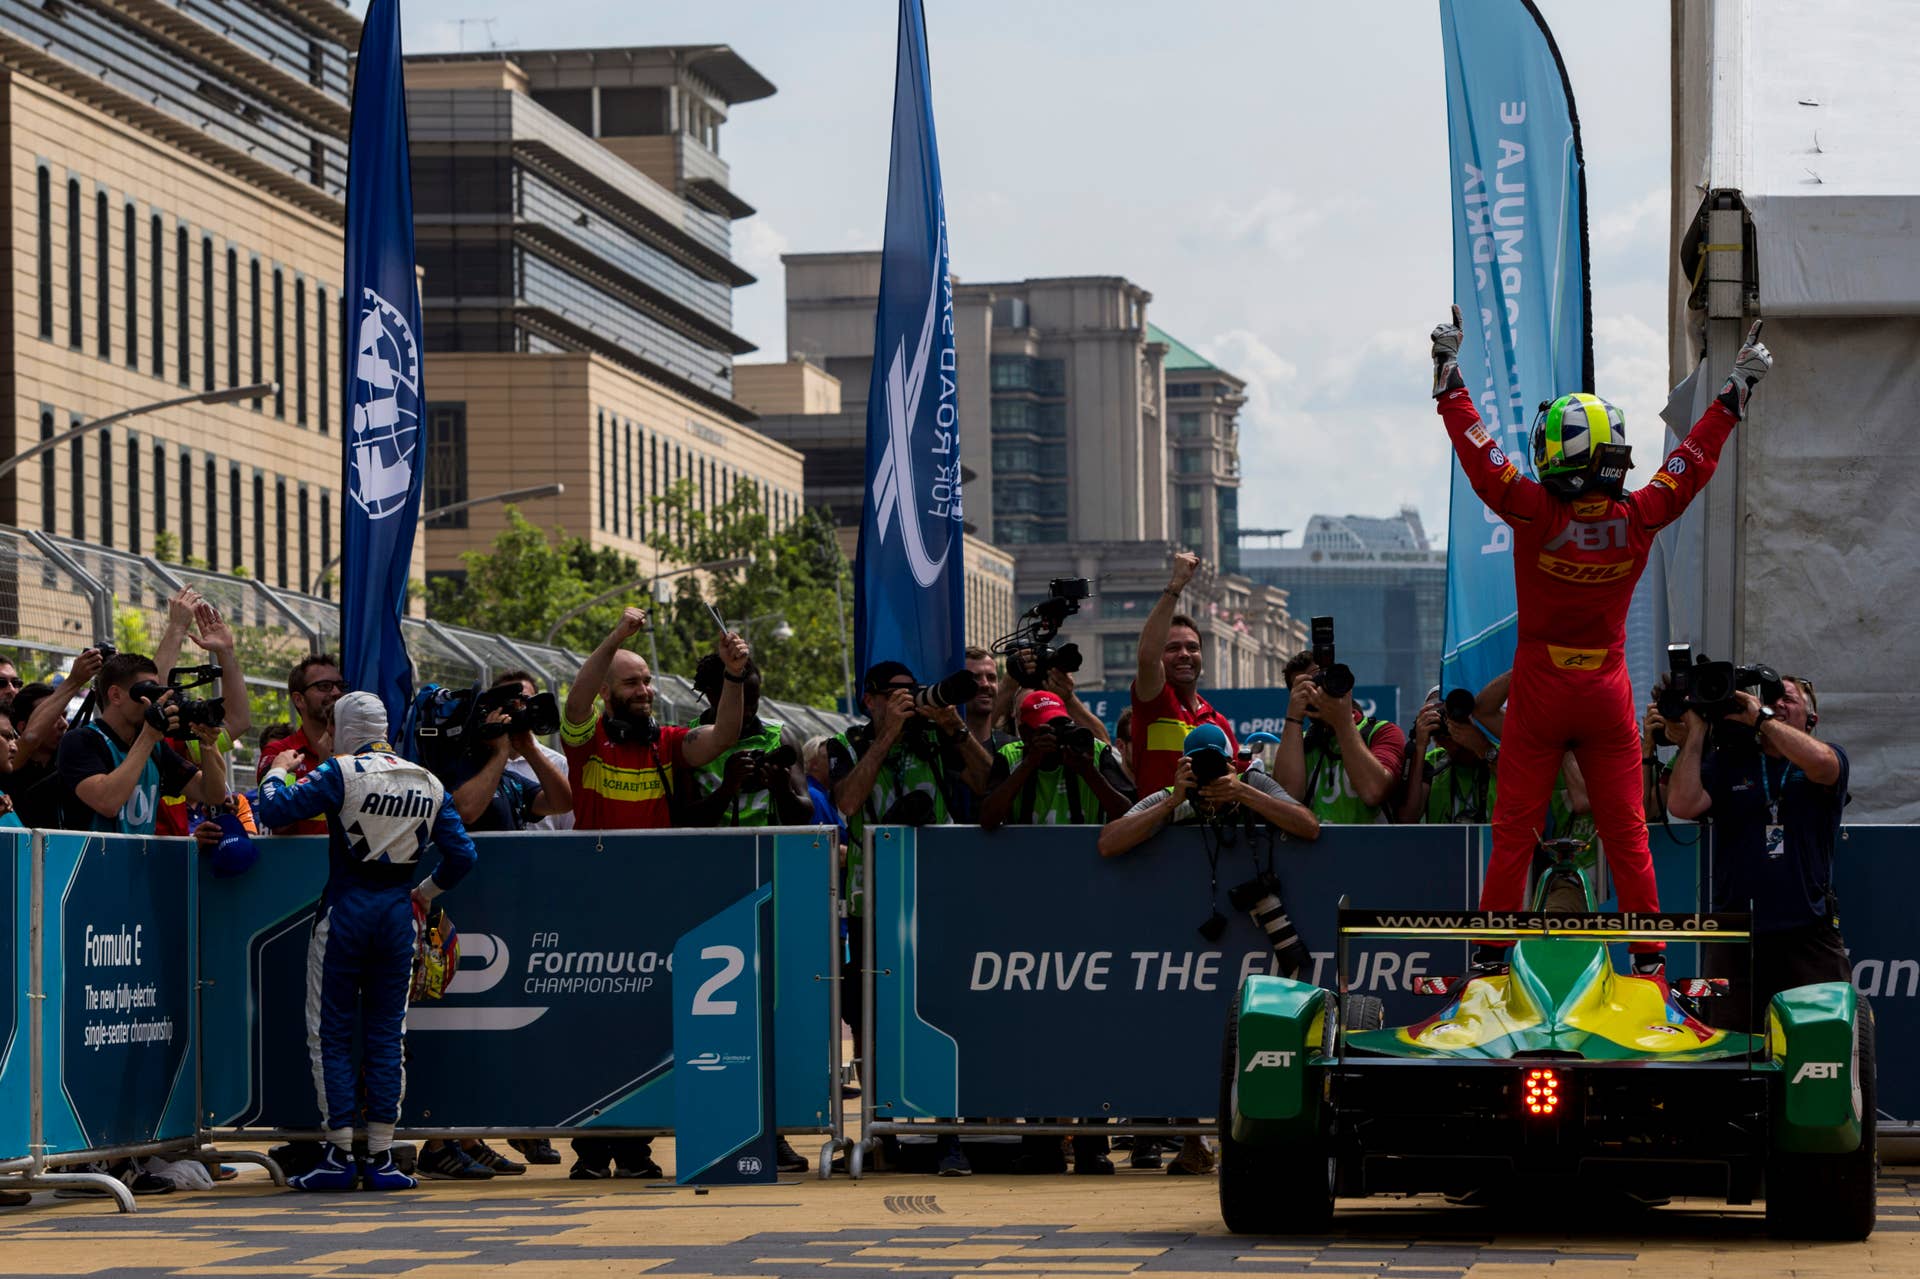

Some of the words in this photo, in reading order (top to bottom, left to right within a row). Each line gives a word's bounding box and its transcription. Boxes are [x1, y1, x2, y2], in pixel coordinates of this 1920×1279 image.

[1600, 466, 1623, 479] LUCAS
[1544, 518, 1629, 551] ABT
[1549, 561, 1621, 581] DHL
[360, 789, 433, 819] Amlin
[1376, 911, 1719, 932] www.abt-sportsline.de
[84, 923, 132, 968] Formula
[134, 923, 142, 967] E
[531, 931, 560, 949] FIA
[691, 944, 745, 1016] 2
[969, 951, 1113, 991] DRIVE
[1130, 951, 1223, 991] THE
[84, 984, 99, 1011] The
[99, 989, 116, 1010] new
[115, 981, 157, 1015] fully-electric
[524, 976, 654, 994] CHAMPIONSHIP
[84, 1019, 130, 1052] single-seater
[130, 1015, 174, 1048] championship
[1244, 1051, 1297, 1073] ABT
[1791, 1062, 1844, 1085] ABT
